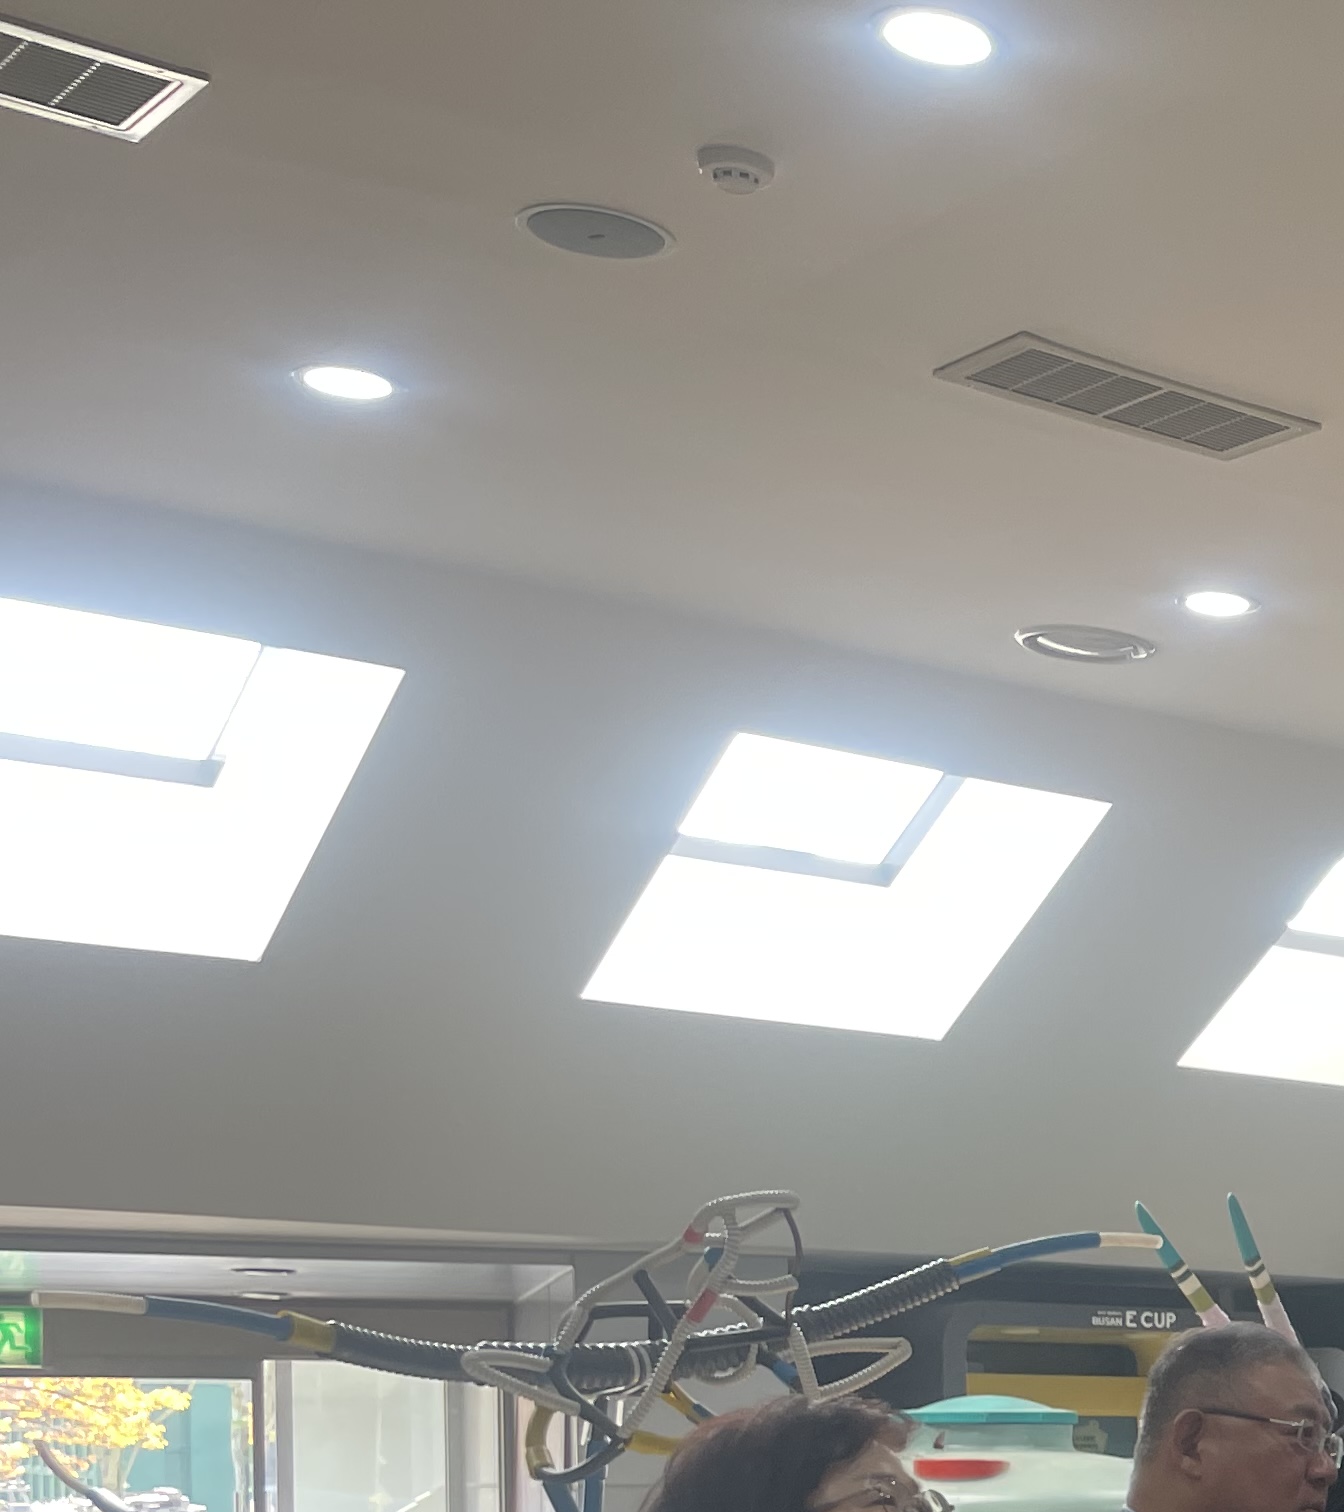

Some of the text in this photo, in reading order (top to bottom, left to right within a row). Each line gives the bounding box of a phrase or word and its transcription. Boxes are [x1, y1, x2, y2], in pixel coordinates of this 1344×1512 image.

[1092, 1310, 1176, 1328] BUSAN E CUP
